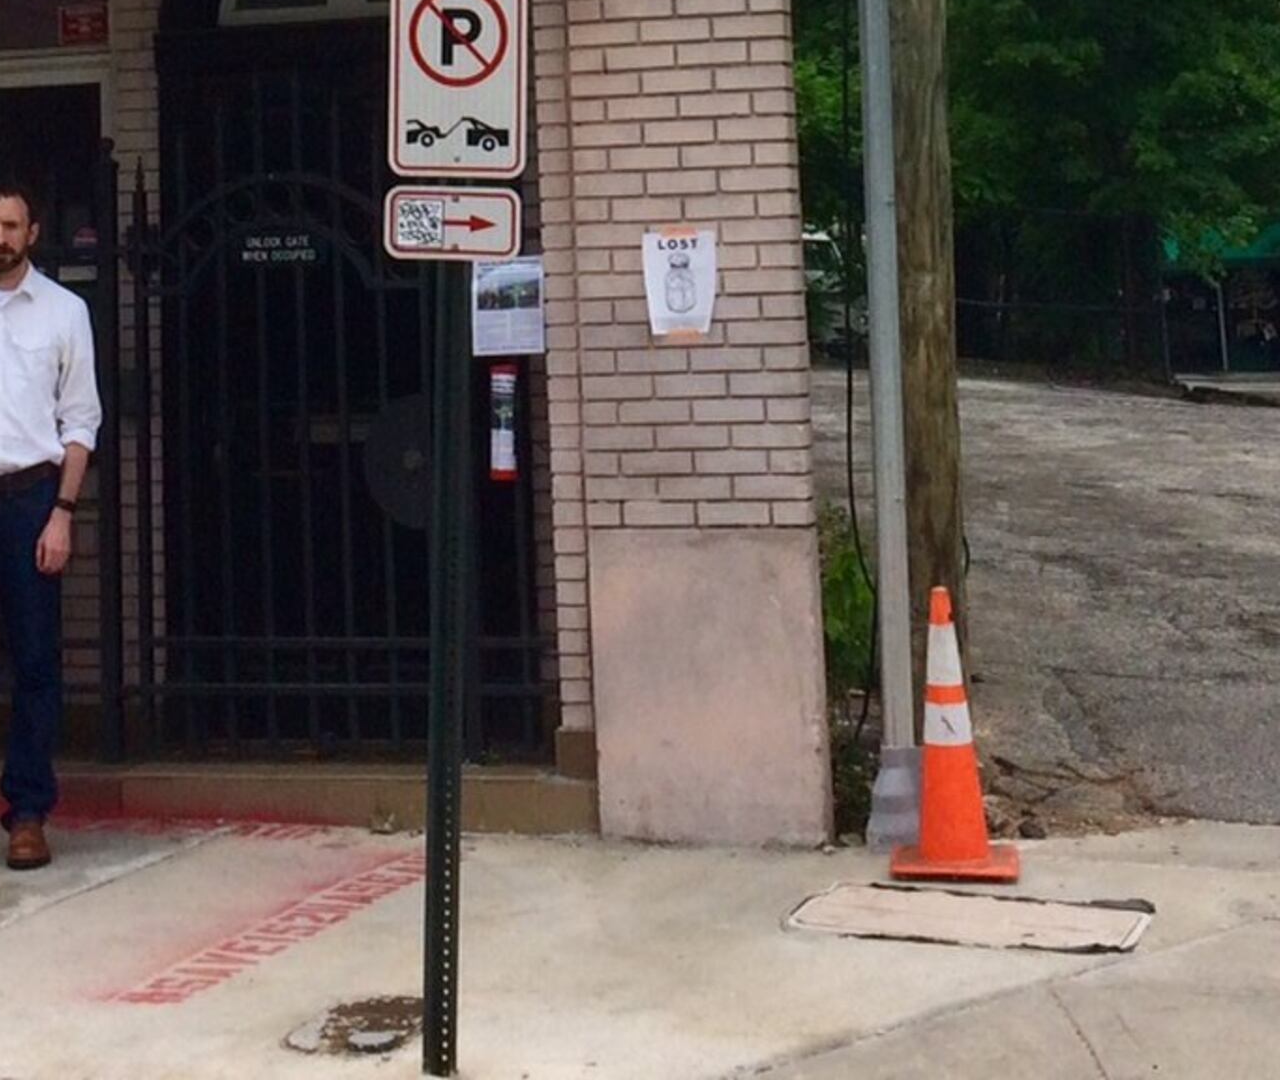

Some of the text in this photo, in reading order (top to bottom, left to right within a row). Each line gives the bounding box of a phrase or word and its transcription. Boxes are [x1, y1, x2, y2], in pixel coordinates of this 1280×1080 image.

[285, 234, 310, 247] GATE
[657, 238, 698, 250] LOST
[242, 251, 269, 262] WHEN
